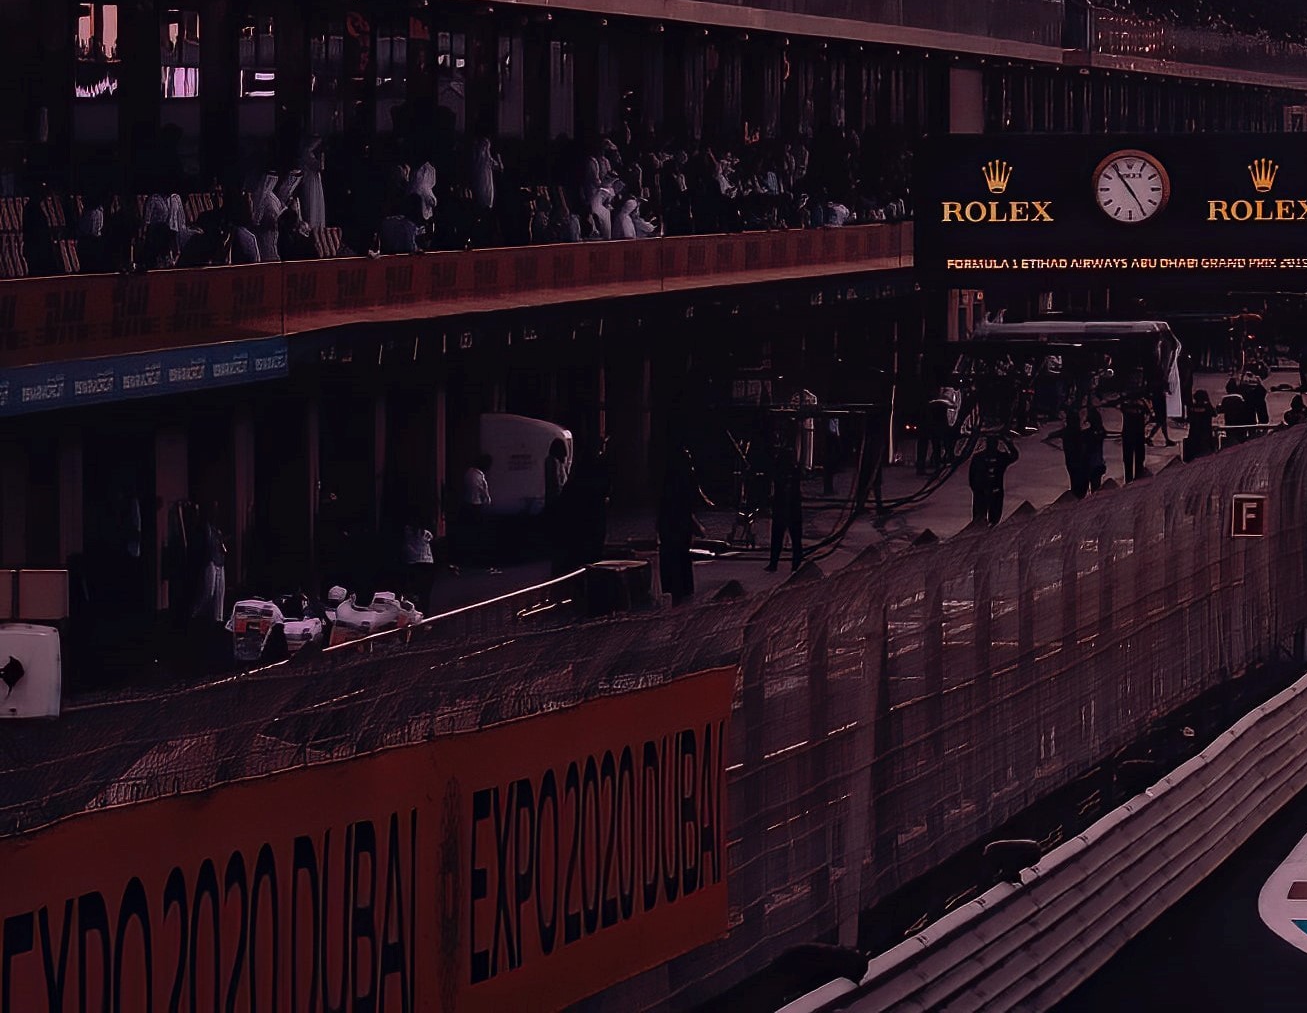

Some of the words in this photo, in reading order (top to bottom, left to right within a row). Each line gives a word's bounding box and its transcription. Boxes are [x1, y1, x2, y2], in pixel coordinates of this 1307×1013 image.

[942, 201, 1054, 222] ROLEX
[947, 259, 1010, 269] FORMULA
[1021, 259, 1068, 269] ETIHAD
[1070, 258, 1128, 268] AIRWAYS
[1131, 259, 1157, 268] ABU
[1160, 259, 1199, 268] DHABI
[1242, 502, 1257, 531] F
[471, 769, 558, 984] EXPO
[564, 745, 635, 944] 2020
[642, 721, 725, 911] DUBAI
